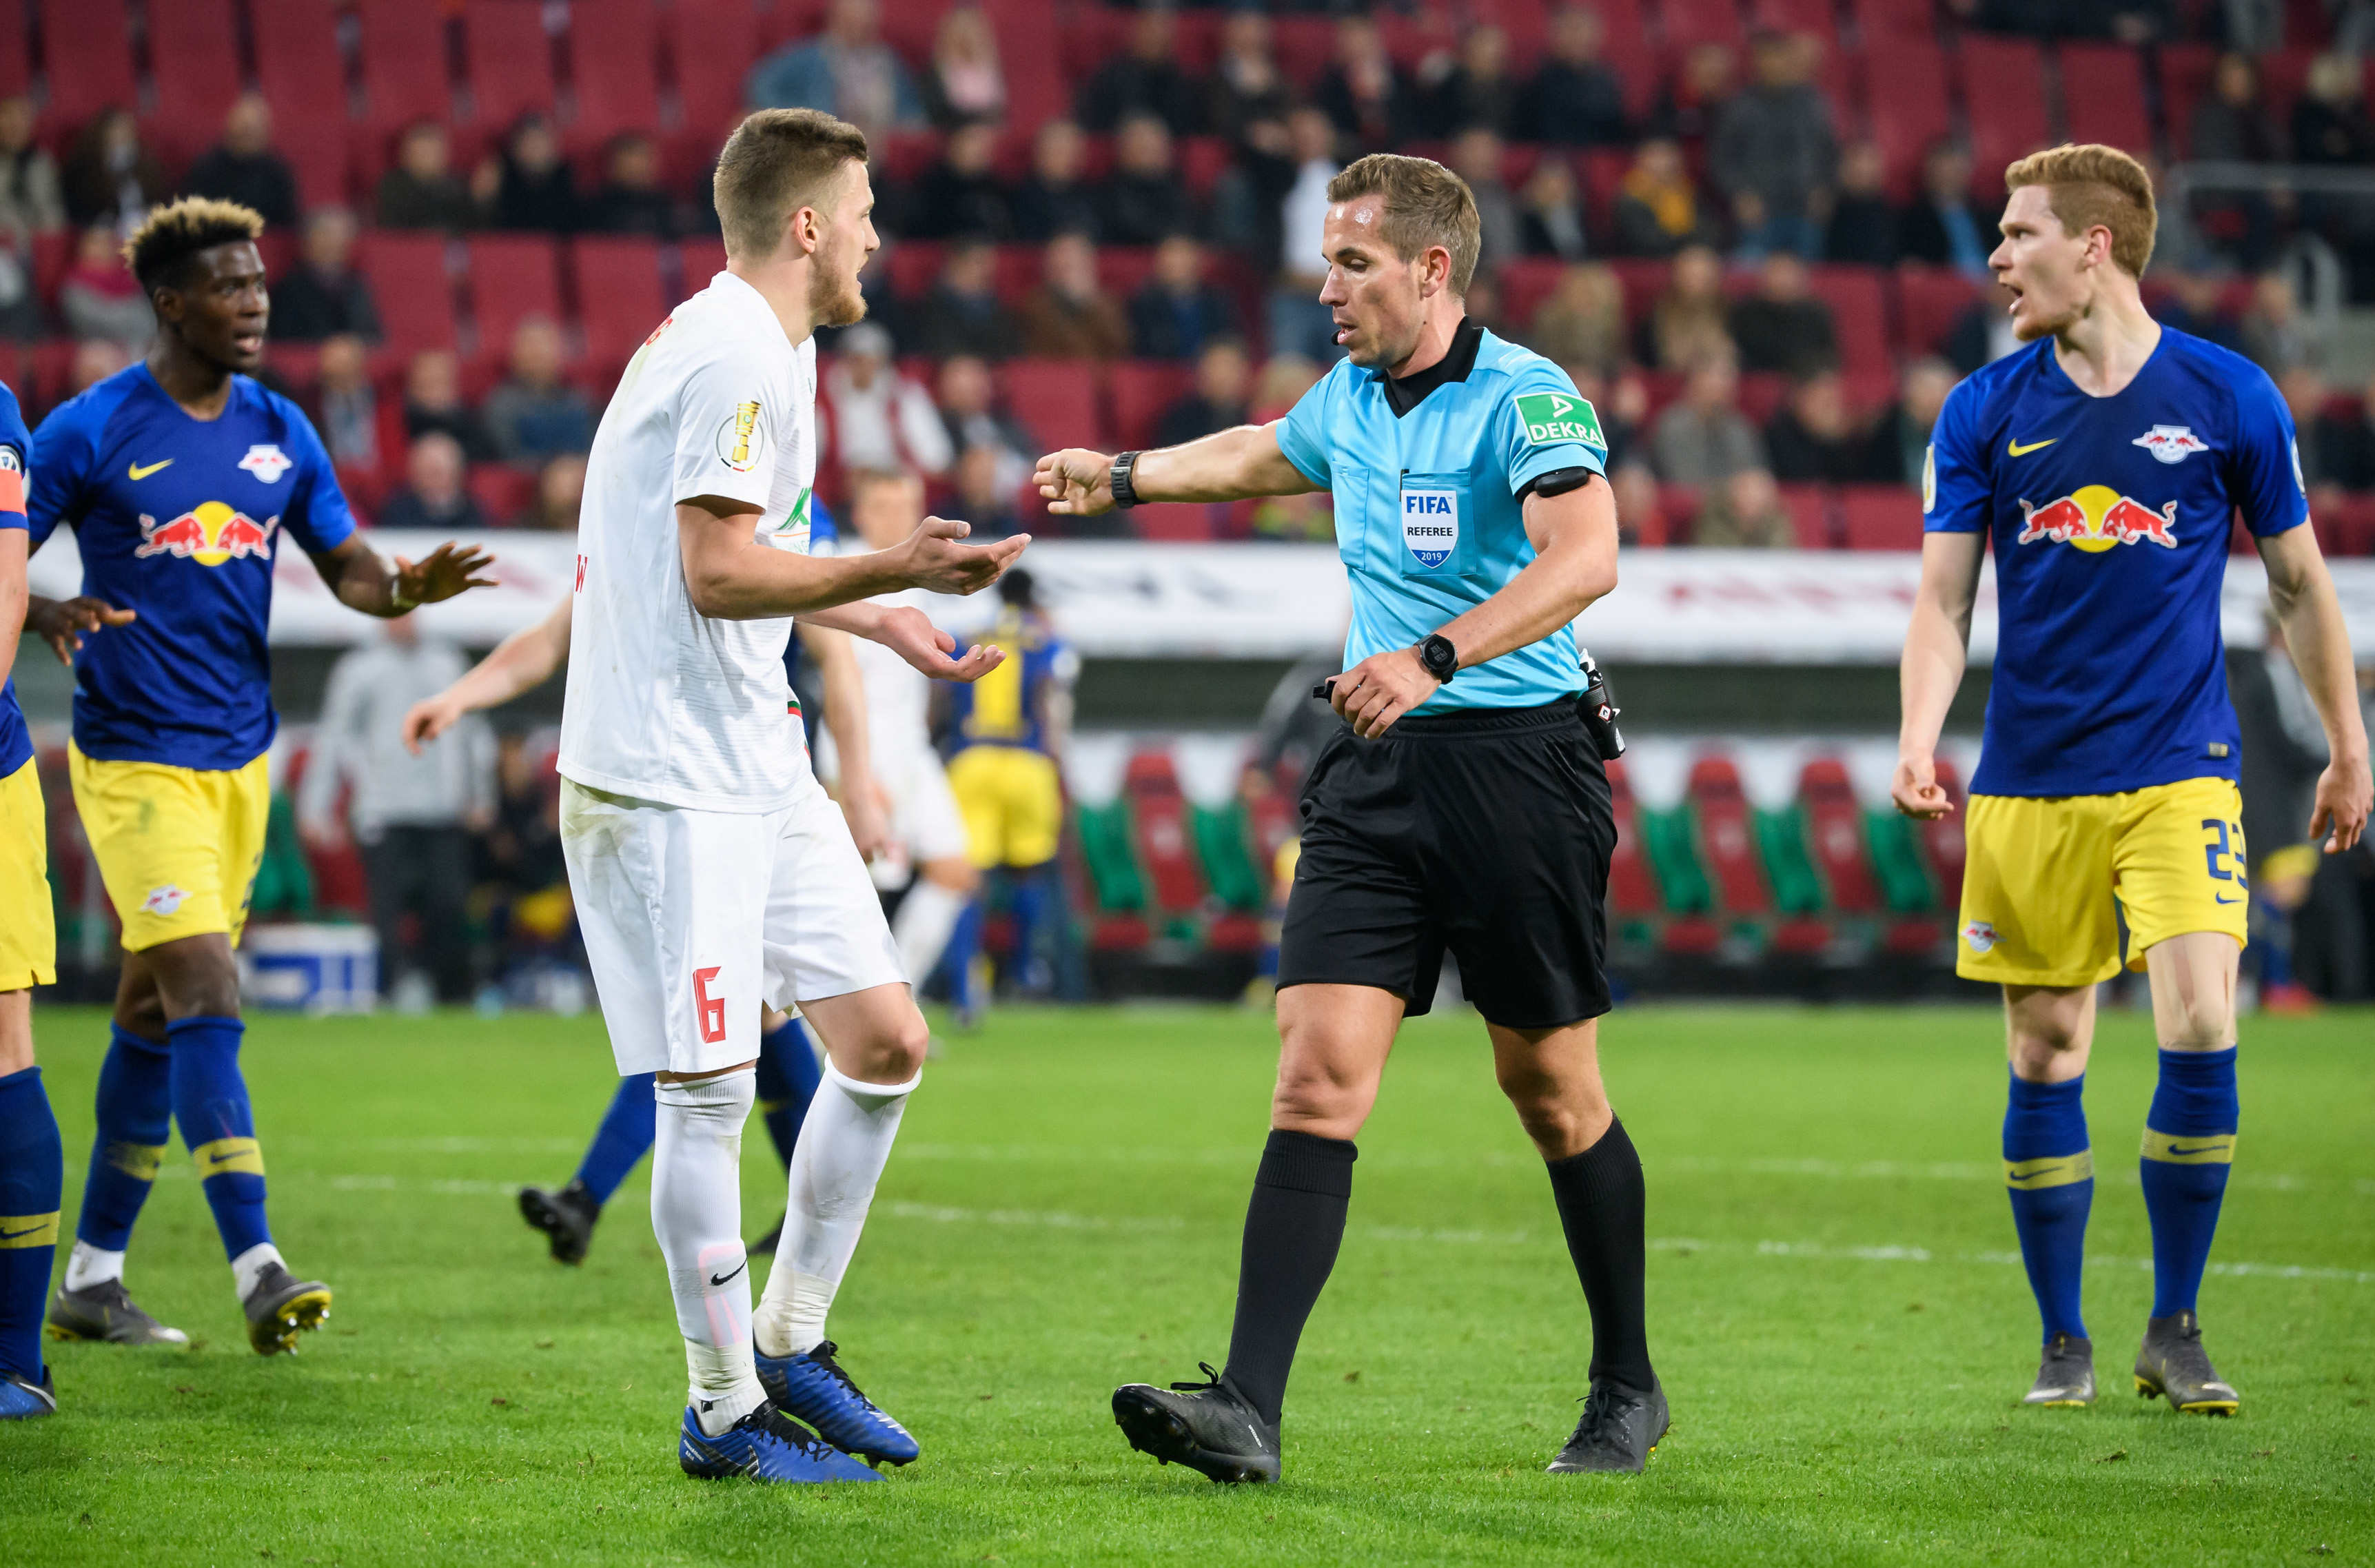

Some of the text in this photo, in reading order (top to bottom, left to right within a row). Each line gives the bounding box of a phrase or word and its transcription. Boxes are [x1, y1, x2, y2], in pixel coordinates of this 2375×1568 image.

[1529, 422, 1604, 446] DEKRA
[1406, 496, 1451, 514] FIFA
[1407, 527, 1454, 536] REFEREE
[1420, 552, 1442, 561] 2019
[2201, 818, 2249, 891] 23
[692, 966, 726, 1044] 6
